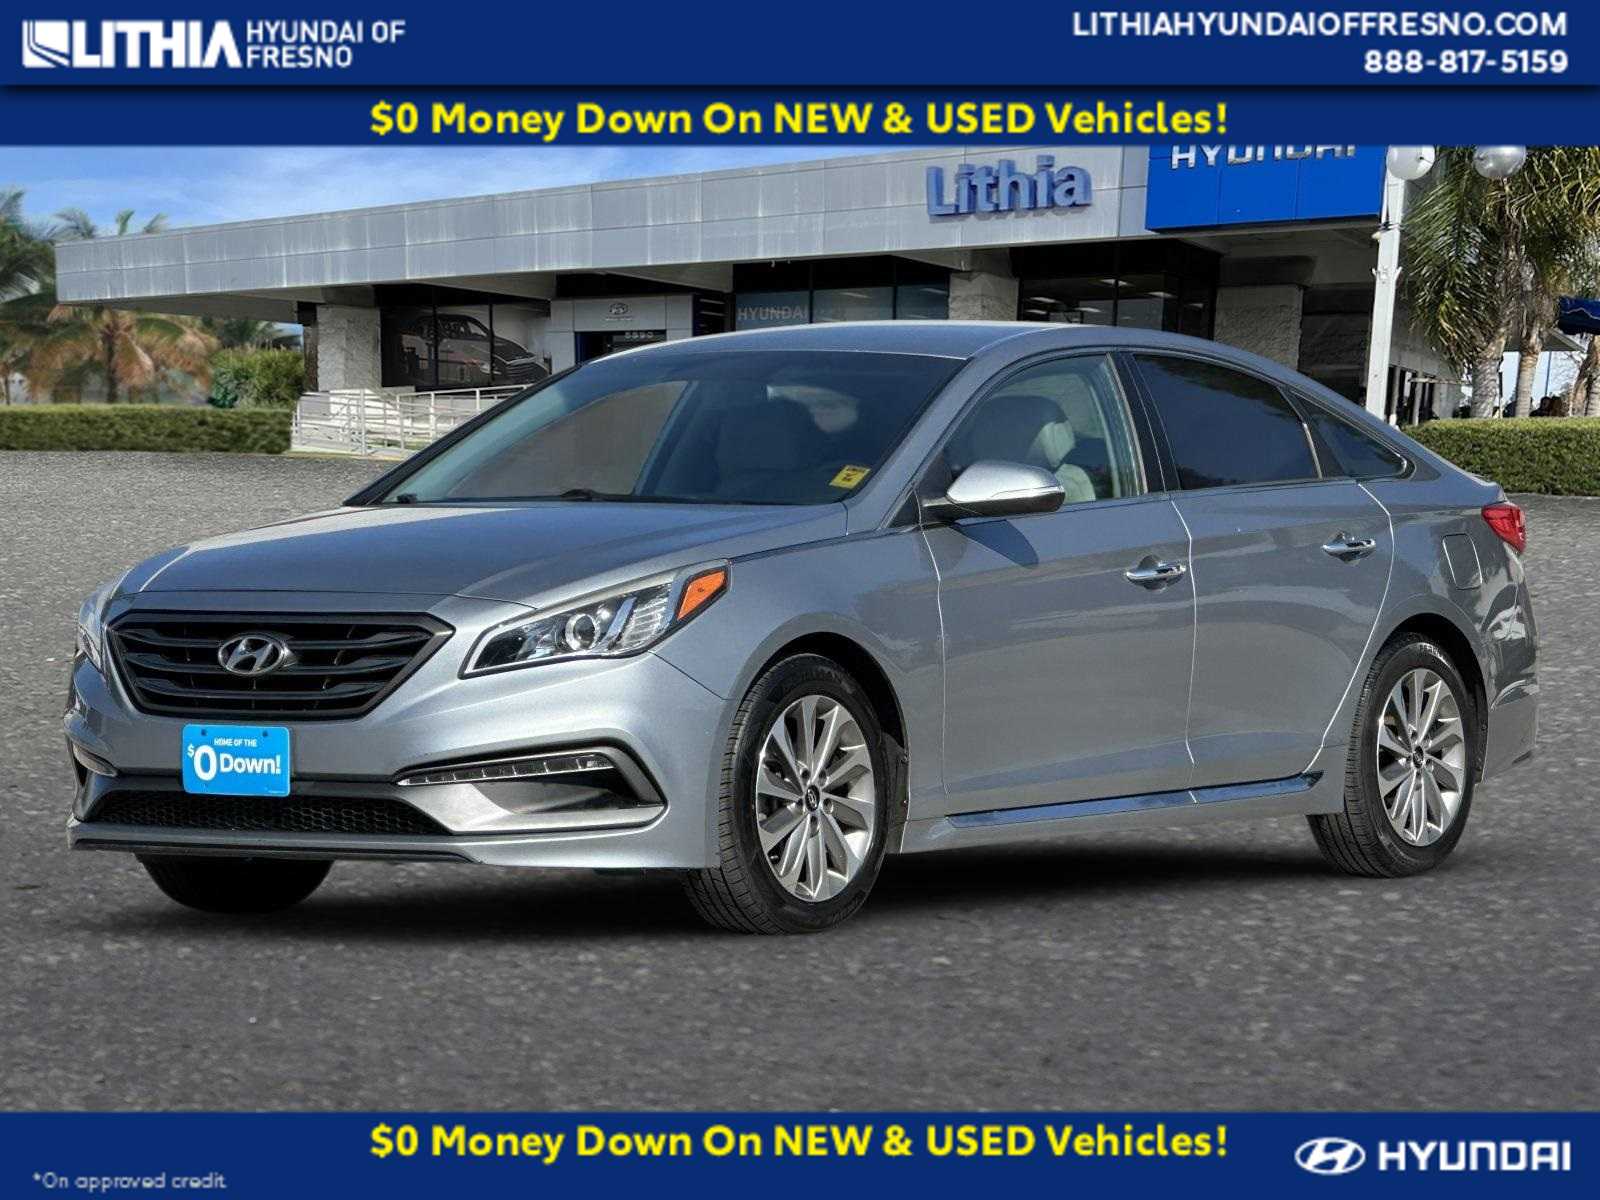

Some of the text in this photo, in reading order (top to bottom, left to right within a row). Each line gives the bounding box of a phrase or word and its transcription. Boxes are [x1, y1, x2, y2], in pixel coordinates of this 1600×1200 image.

[926, 154, 1092, 216] Lithia
[737, 306, 810, 321] HYUNDAI
[213, 738, 258, 748] HOME OF THE
[219, 753, 282, 775] Down!
